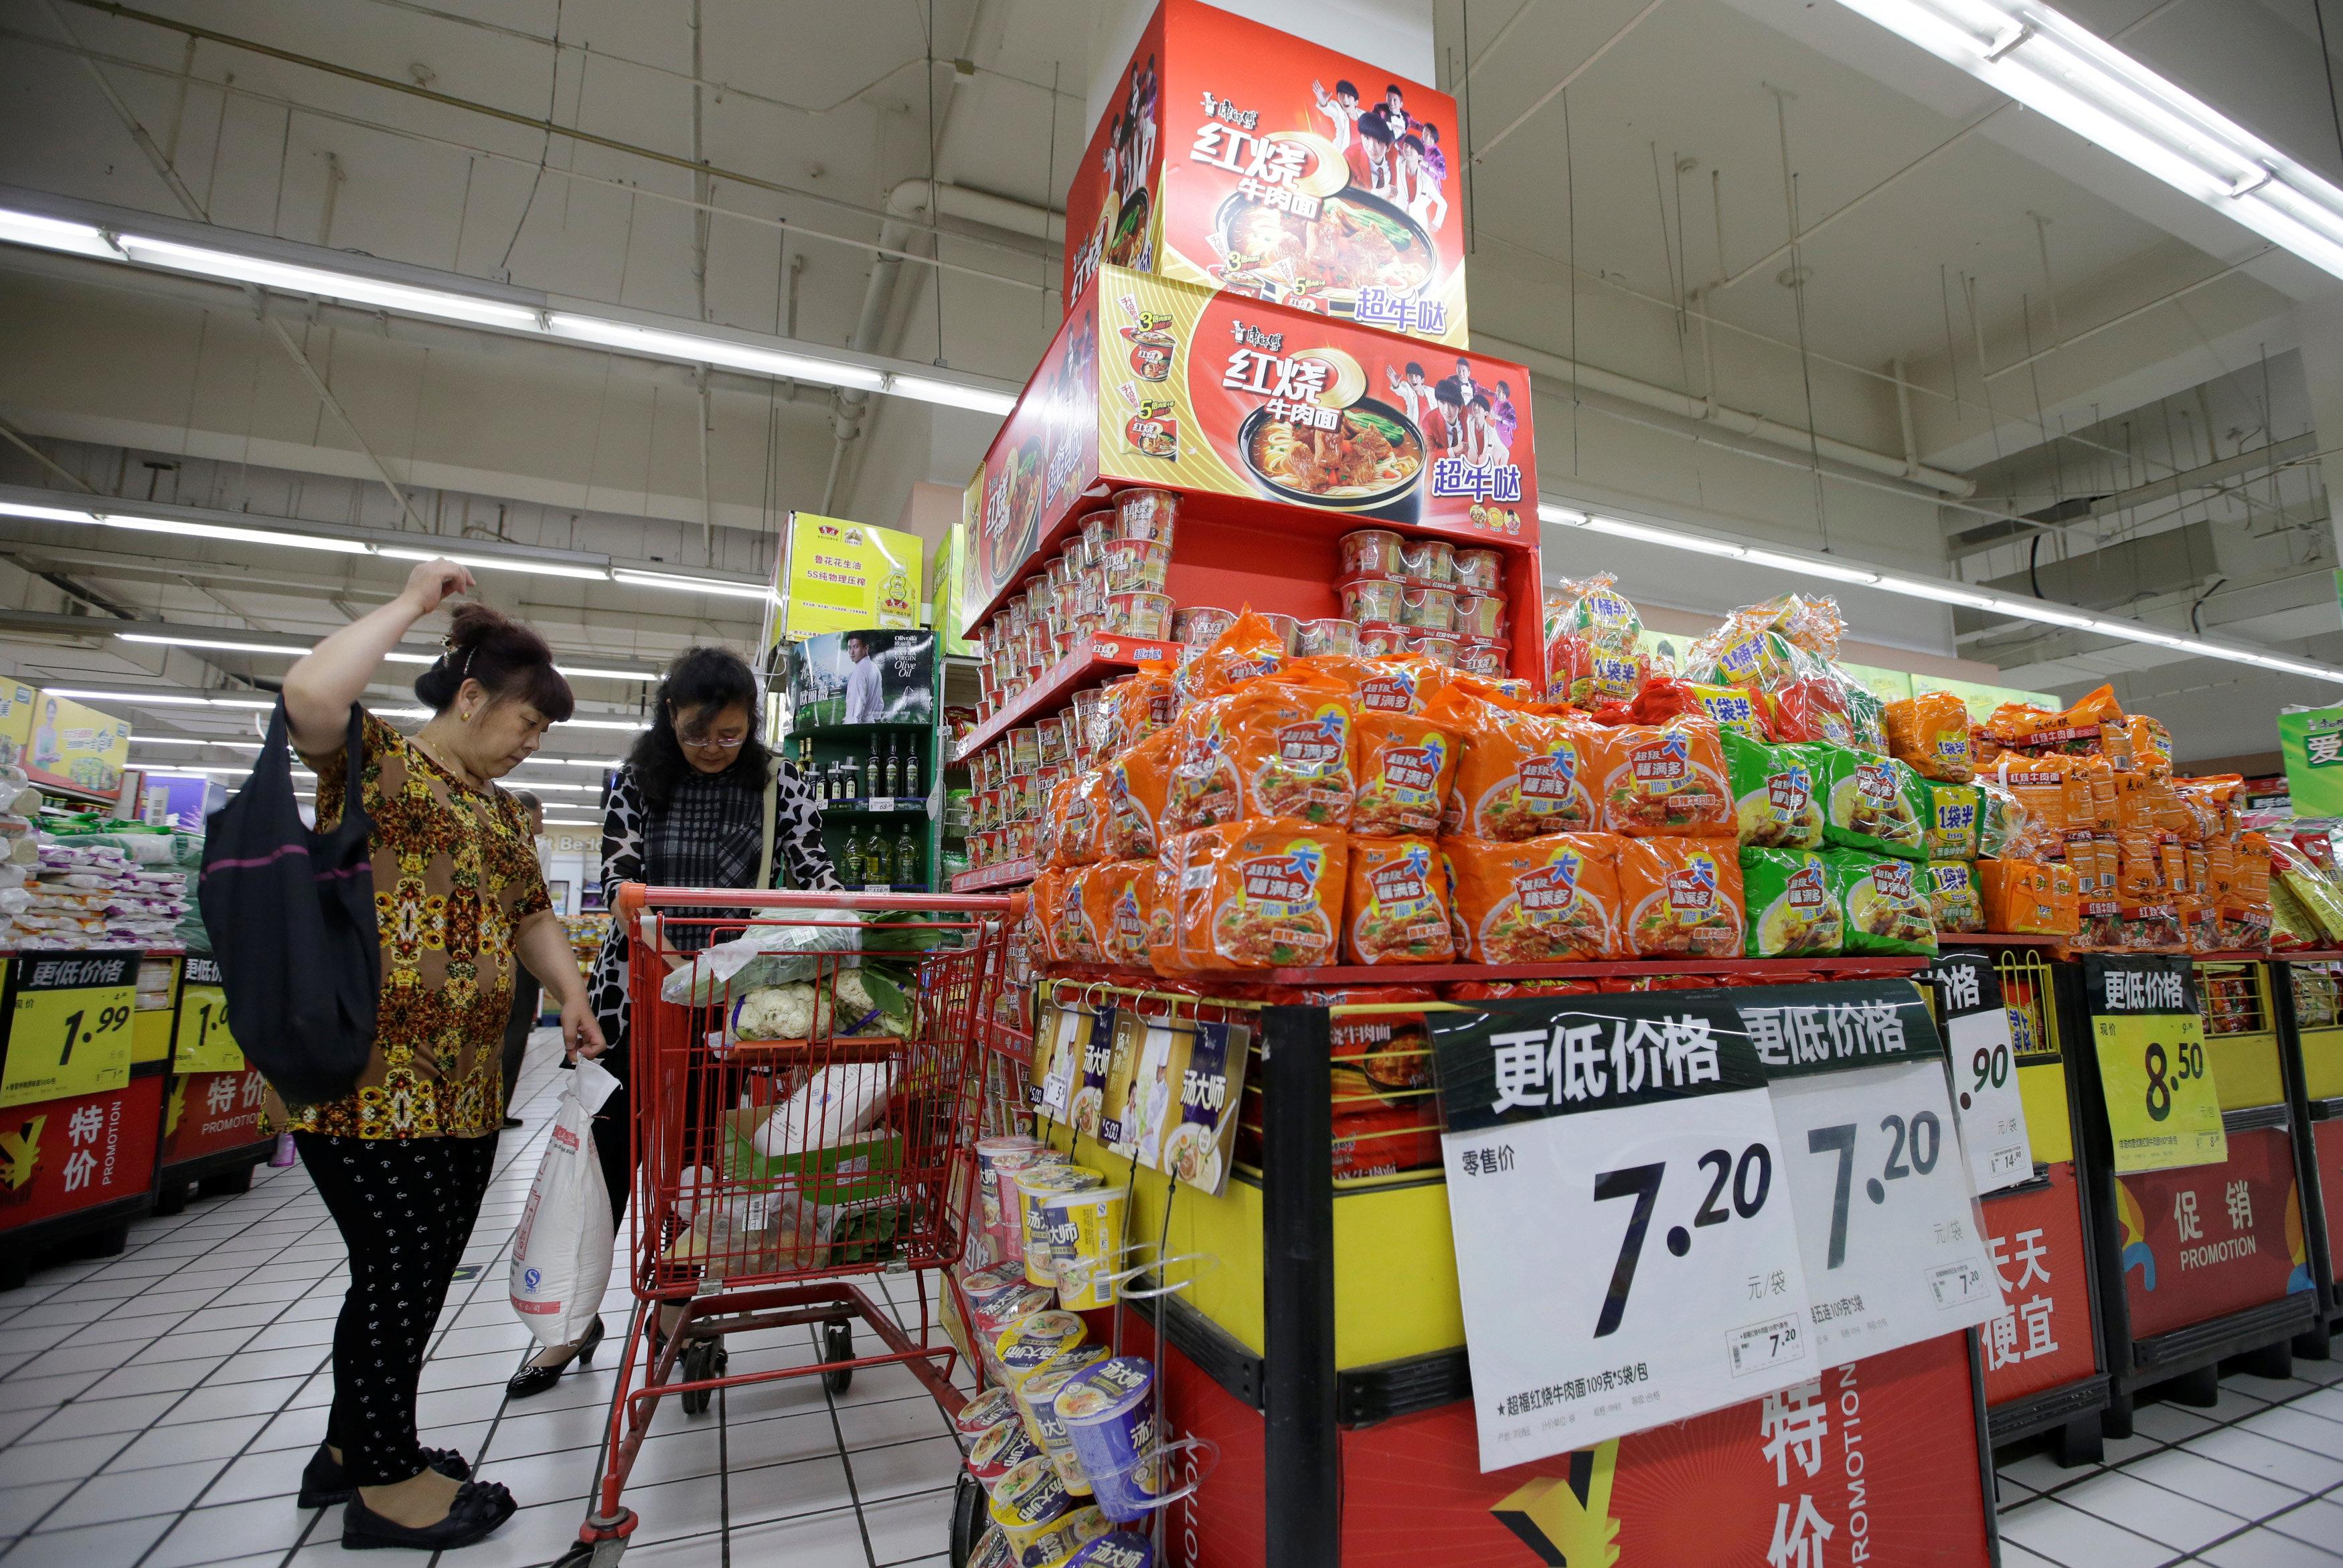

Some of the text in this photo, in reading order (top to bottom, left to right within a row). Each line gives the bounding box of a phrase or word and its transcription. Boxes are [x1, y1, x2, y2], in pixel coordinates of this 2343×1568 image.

[1190, 121, 1306, 190] 红烧
[1237, 177, 1321, 219] 牛肉面
[1355, 286, 1447, 334] 超牛哒
[1222, 347, 1327, 404] 红烧
[1265, 398, 1341, 431] 牛肉面
[1432, 454, 1522, 502] 超牛哒
[814, 554, 862, 571] 鲁花花生油
[807, 570, 866, 586] 5S纯物理压榨
[894, 661, 917, 670] Olive
[898, 669, 912, 678] Oil
[1393, 670, 1415, 695] 大
[1366, 695, 1408, 709] 福满多
[1704, 698, 1751, 721] 1袋半
[1319, 711, 1346, 744] 大
[2030, 728, 2077, 745] 红烧牛肉面
[1283, 742, 1340, 760] 福满多
[1421, 739, 1445, 772] 大
[1633, 749, 1666, 762] 超级
[1662, 730, 1689, 761] 大
[1937, 739, 1966, 757] 1袋半
[1386, 768, 1431, 787] 福满多
[1552, 747, 1575, 780] 大
[1637, 762, 1682, 776] 福满多
[1877, 760, 1896, 788] 大
[2010, 772, 2060, 783] 红烧牛肉面
[1524, 778, 1565, 796] 福满多
[1789, 766, 1810, 792] 大
[1938, 804, 1974, 830] 1袋半
[1287, 849, 1320, 881] 大
[1405, 847, 1428, 877] 大
[1552, 854, 1580, 885] 大
[1690, 857, 1716, 890] 大
[1807, 857, 1824, 887] 大
[1247, 879, 1310, 898] 福满多
[1377, 883, 1424, 899] 福满多
[1524, 890, 1570, 906] 福满多
[1672, 890, 1710, 905] 福满多
[1789, 889, 1822, 903] 福满多
[2089, 901, 2118, 916] 红烧牛肉面
[29, 960, 126, 987] 更低价格
[2103, 969, 2184, 1011] 更低价格
[59, 1005, 131, 1066] 1.99
[1742, 998, 1908, 1066] 更低价格
[2099, 1022, 2116, 1036] 现价
[1489, 1014, 1721, 1114] 更低价格
[206, 1071, 264, 1116] 特价
[1180, 1069, 1226, 1113] 汤大师
[2145, 1042, 2204, 1122] 8.50
[201, 1112, 260, 1136] PROMOTIO
[1997, 1117, 2018, 1136] 元/袋
[63, 1104, 104, 1193] 特价
[101, 1100, 123, 1187] PROMOTION
[1461, 1144, 1516, 1177] 零售价
[2004, 1150, 2022, 1169] 14.90
[1807, 1110, 1941, 1272] 7.20
[1593, 1142, 1773, 1339] 7.20
[1933, 1218, 1966, 1247] 元/袋
[2180, 1235, 2257, 1272] PROMOTION
[1748, 1270, 1787, 1301] 元/袋
[1959, 1270, 1980, 1295] 7.20
[1769, 1328, 1797, 1358] 7.20
[1981, 1294, 2058, 1372] 便宜
[1098, 1361, 1149, 1389] 汤大师
[1088, 1541, 1145, 1568] 汤大师
